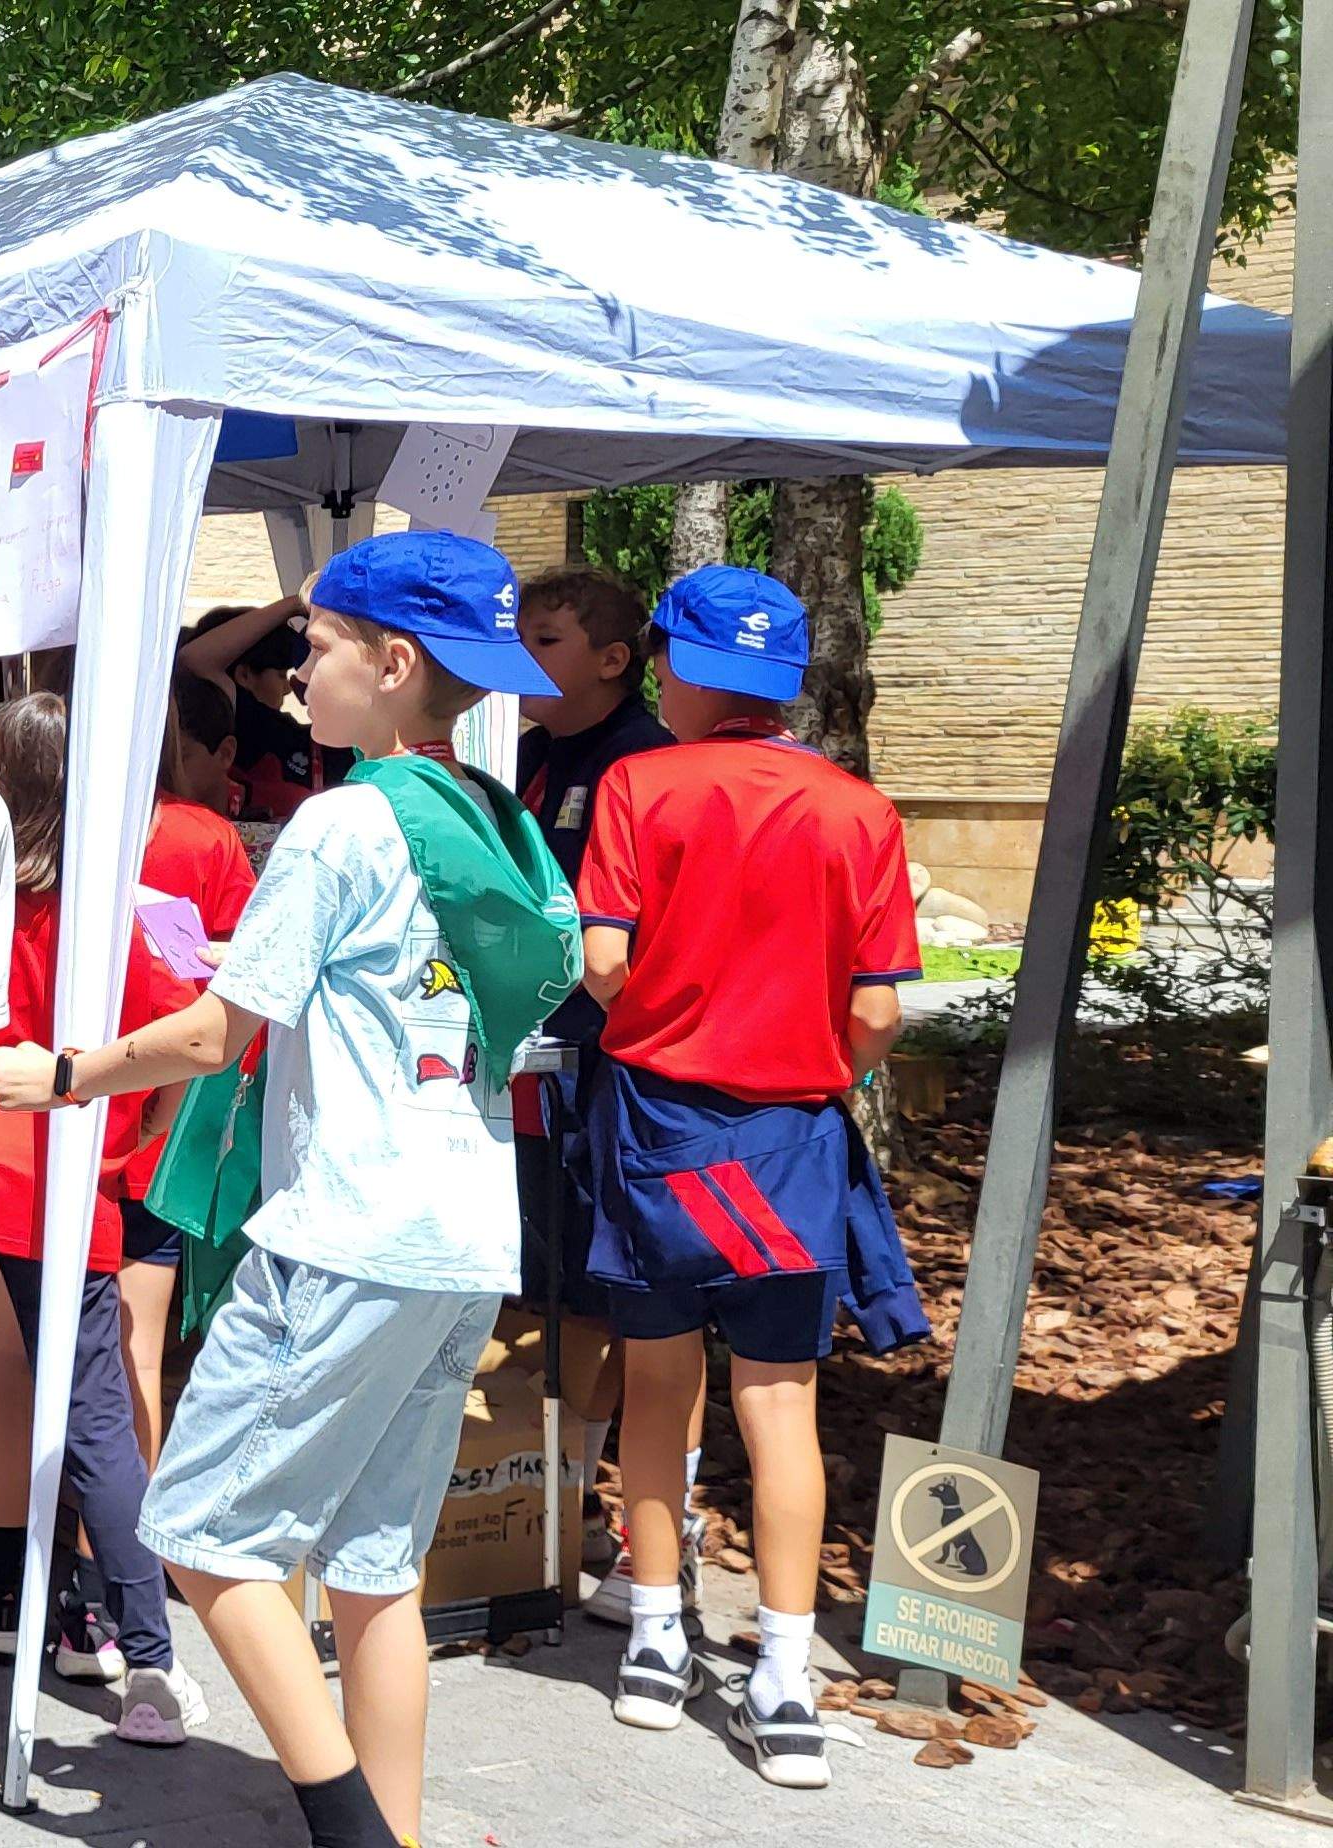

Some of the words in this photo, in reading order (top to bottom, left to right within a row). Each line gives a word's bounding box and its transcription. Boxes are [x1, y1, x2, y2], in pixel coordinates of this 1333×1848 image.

[897, 1595, 921, 1623] SE
[924, 1602, 999, 1647] PROHIBE
[876, 1623, 939, 1659] ENTRAR
[940, 1639, 1010, 1683] MASCOTA
